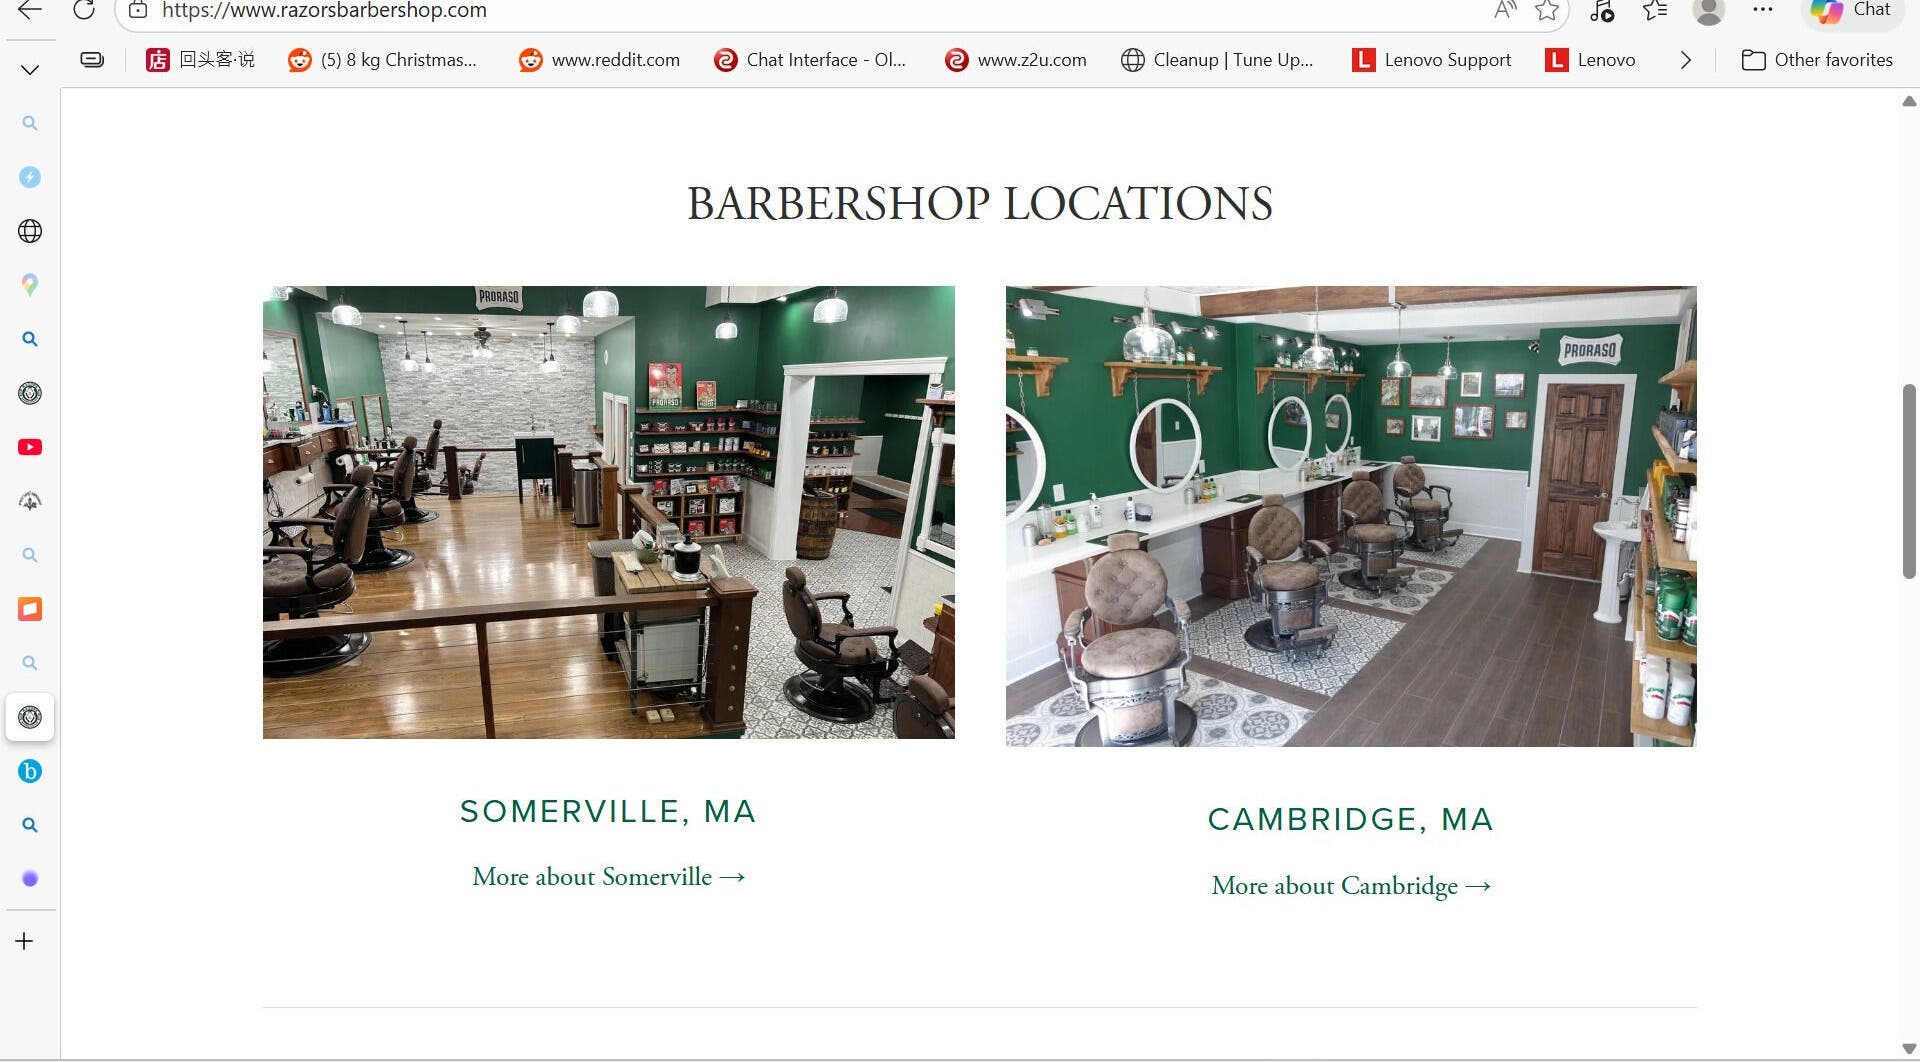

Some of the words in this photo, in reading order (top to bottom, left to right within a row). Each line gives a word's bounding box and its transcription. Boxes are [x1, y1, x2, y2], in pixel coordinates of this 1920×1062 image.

[162, 0, 487, 23] https://www.razorsbarbershop.com
[1854, 0, 1892, 17] Chat
[180, 49, 256, 69] 回头客·说
[321, 51, 342, 71] (5)
[346, 52, 357, 67] 8
[361, 51, 381, 71] kg
[385, 51, 477, 67] Christmas...
[551, 51, 680, 67] www.reddit.com
[747, 51, 784, 67] Chat
[789, 51, 858, 67] Interface
[977, 52, 1087, 67] www.z2u.com
[1154, 51, 1219, 71] Cleanup
[1232, 52, 1273, 67] Tune
[1277, 52, 1313, 71] Up...
[1385, 52, 1443, 67] Lenovo
[1448, 52, 1512, 71] Support
[1578, 52, 1636, 67] Lenovo
[1775, 51, 1822, 67] Other
[1825, 51, 1894, 67] favorites
[687, 185, 990, 221] BARBERSHOP
[1003, 184, 1273, 221] LOCATIONS
[479, 289, 519, 303] PRORASO
[1564, 342, 1617, 358] PRORASO
[460, 799, 689, 827] SOMERVILLE,
[705, 799, 756, 823] MA
[1208, 807, 1426, 835] CAMBRIDGE,
[1442, 807, 1494, 831] MA
[472, 866, 529, 886] More
[535, 865, 596, 886] about
[602, 865, 713, 887] Somerville
[1211, 875, 1269, 895] More
[1274, 874, 1335, 895] about
[1341, 874, 1459, 902] Cambridge
